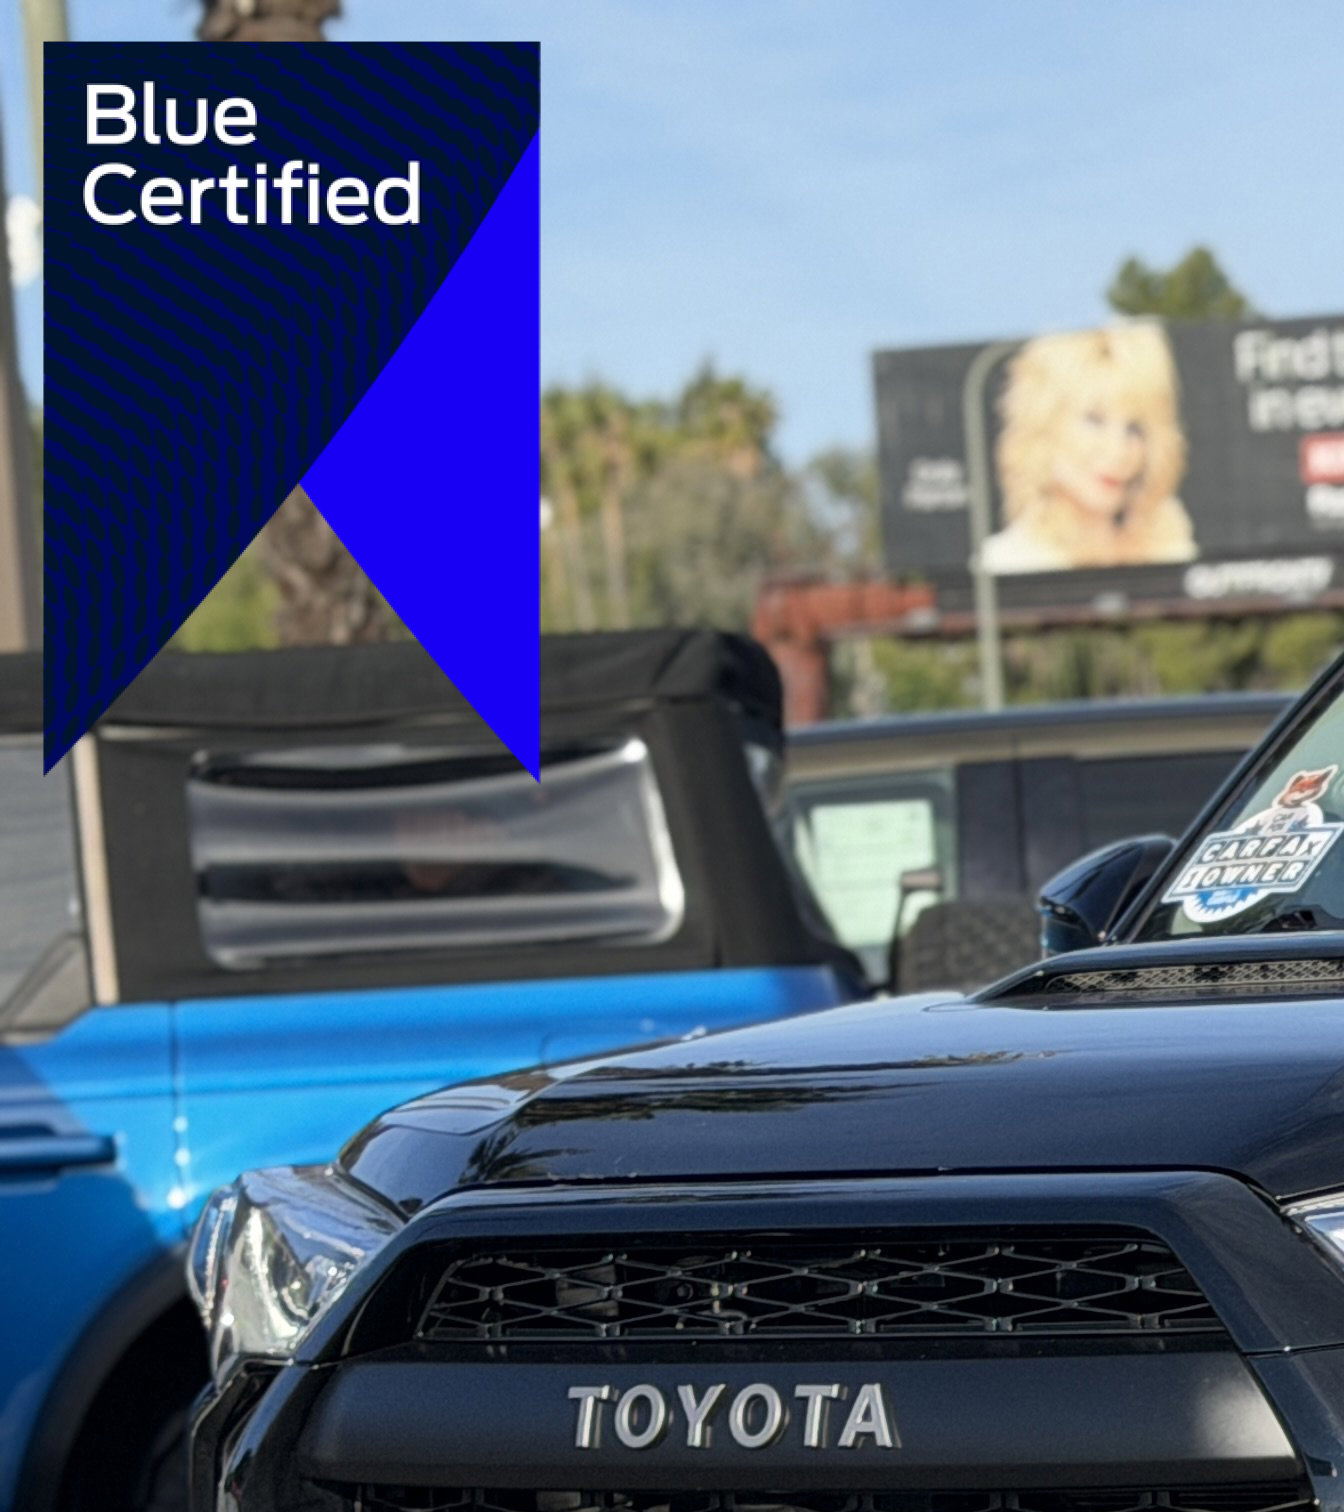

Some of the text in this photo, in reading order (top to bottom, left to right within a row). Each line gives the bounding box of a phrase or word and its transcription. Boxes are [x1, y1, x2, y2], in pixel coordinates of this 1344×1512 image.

[1234, 326, 1330, 383] Find
[1248, 386, 1294, 431] in
[1201, 835, 1321, 863] CARFAX
[568, 1383, 895, 1449] TOYOTA
